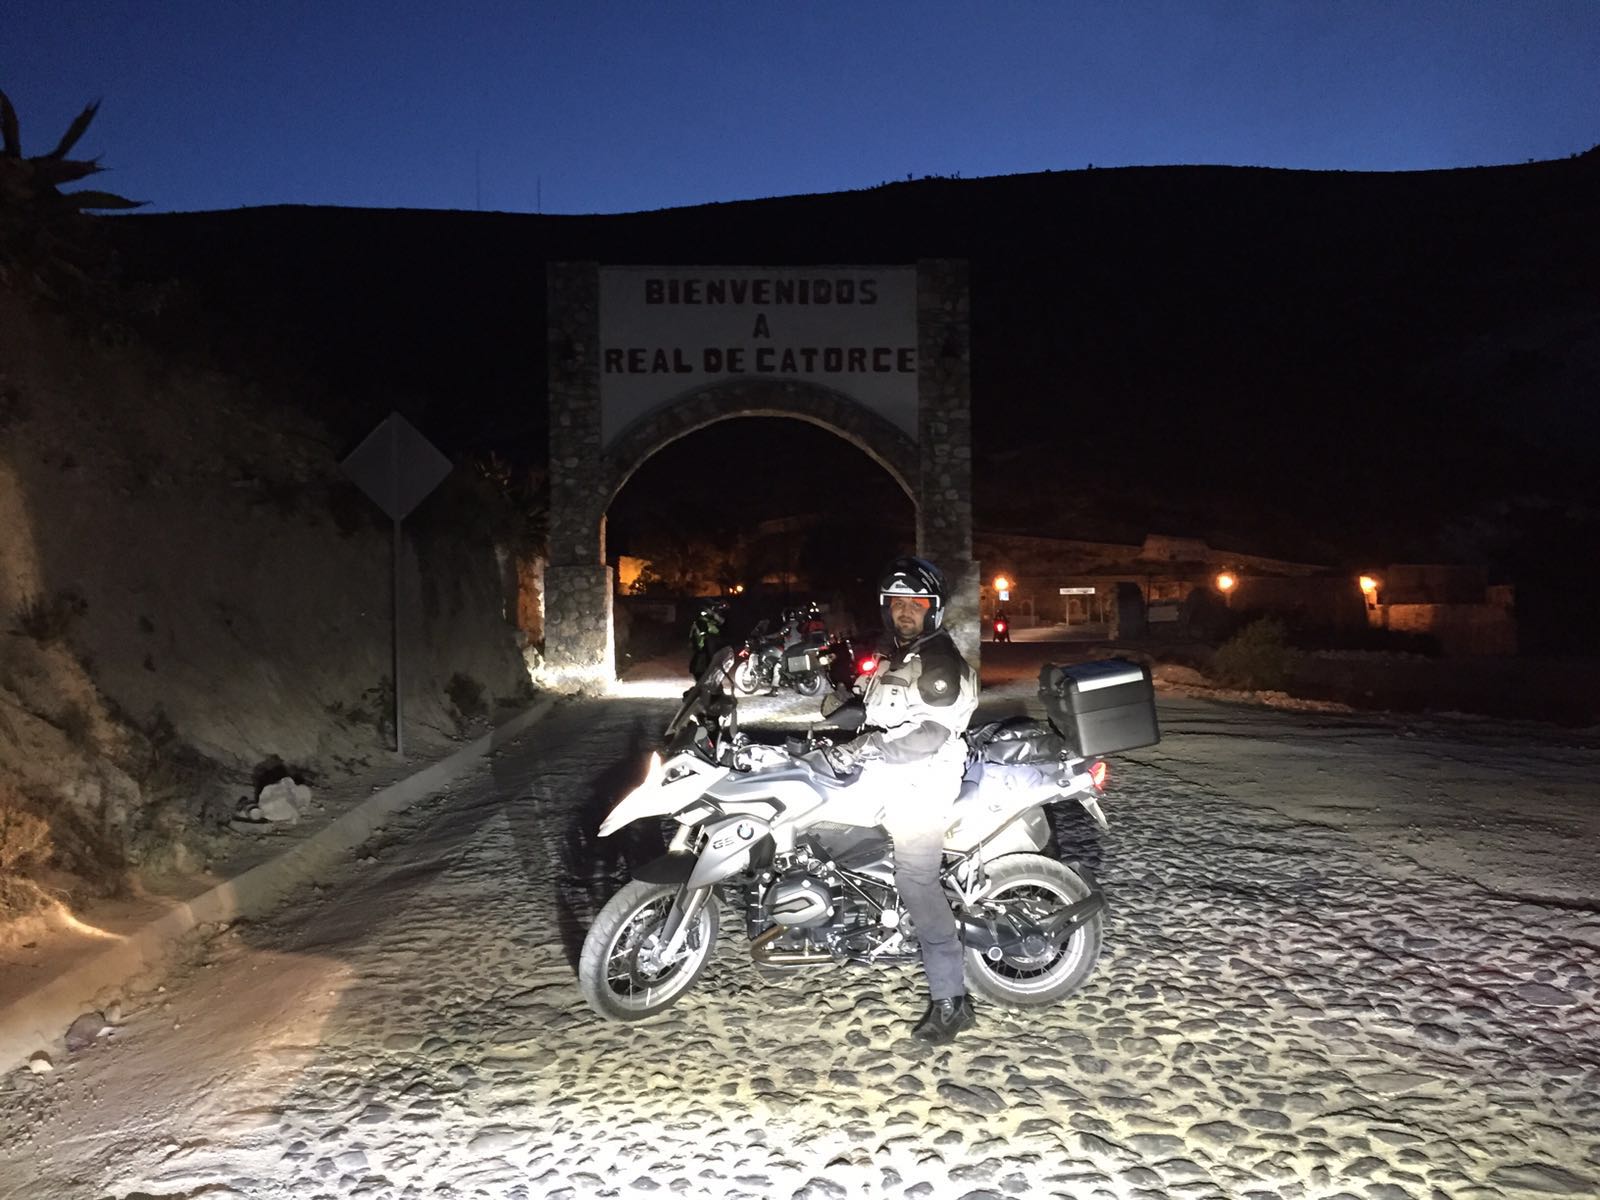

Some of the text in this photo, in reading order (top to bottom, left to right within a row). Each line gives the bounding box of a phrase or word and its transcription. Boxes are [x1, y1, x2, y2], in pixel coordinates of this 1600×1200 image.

[645, 278, 878, 305] BIENVENIDOS
[752, 313, 771, 339] A
[604, 347, 917, 374] REAL DE CATORCE
